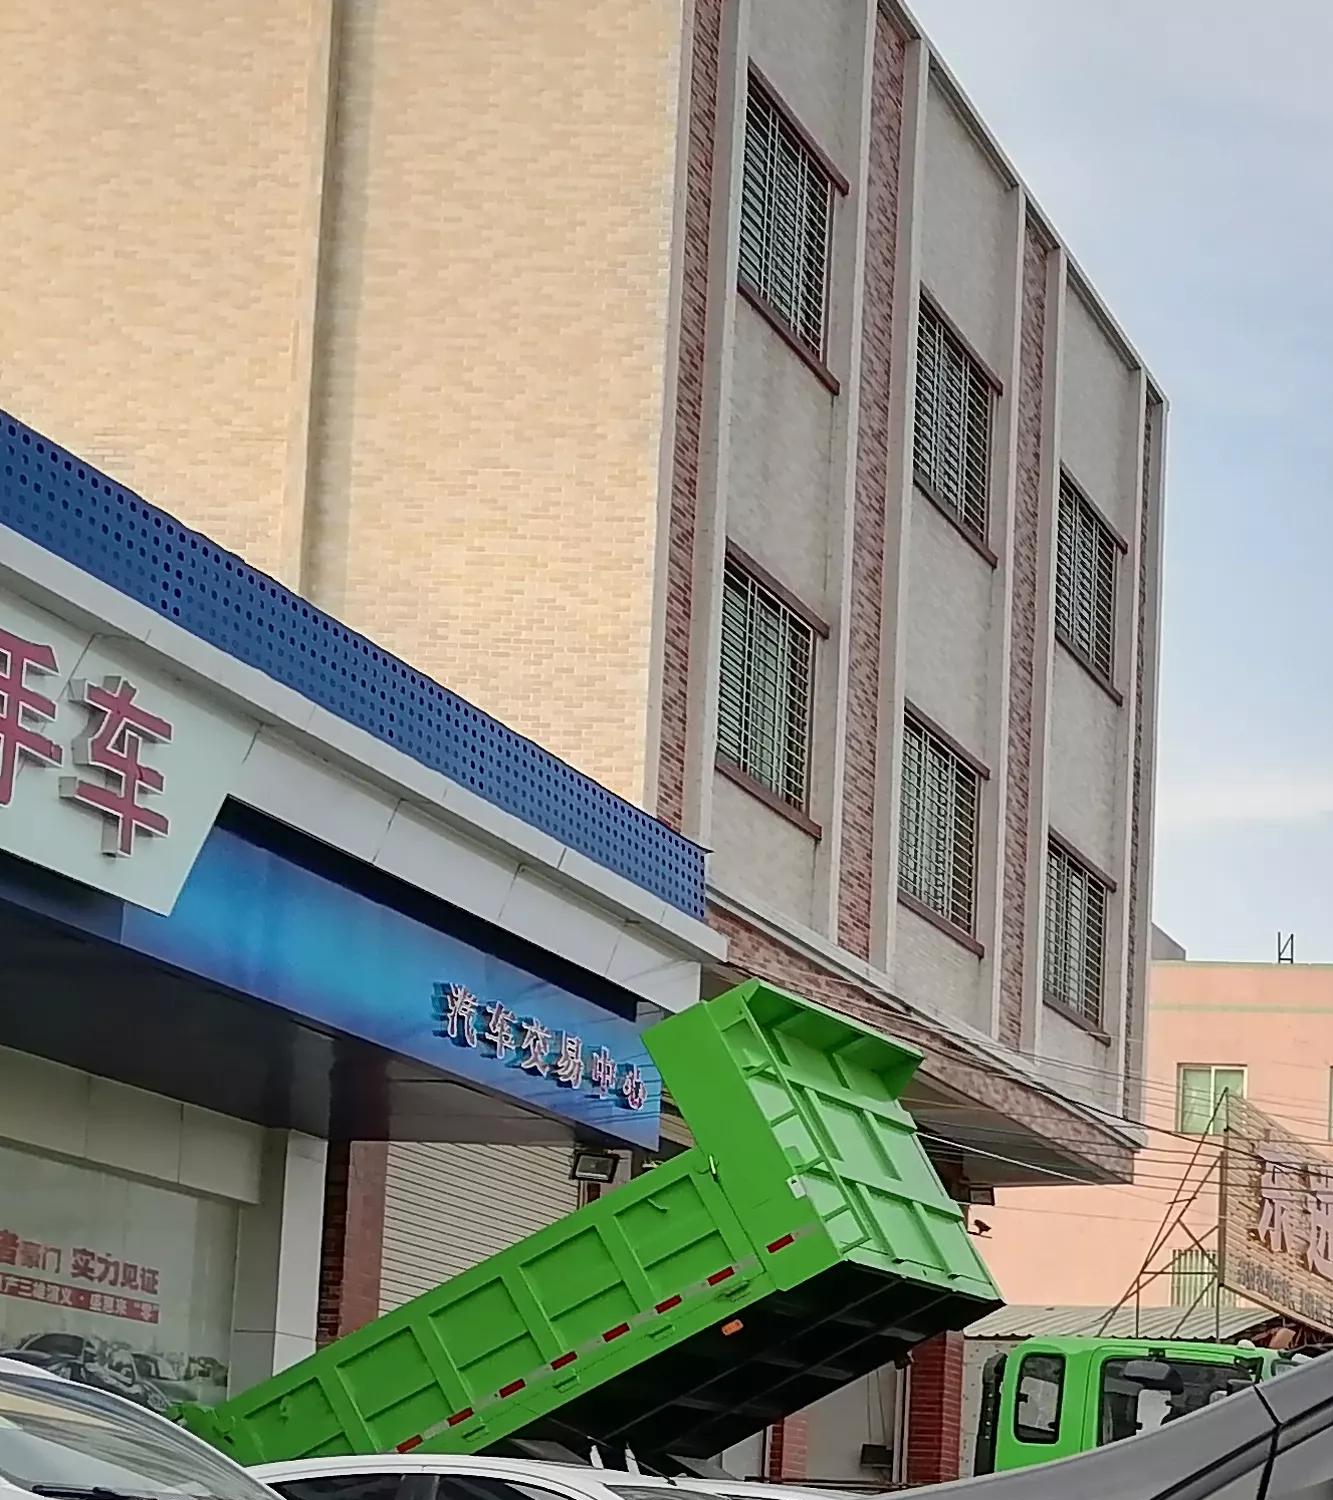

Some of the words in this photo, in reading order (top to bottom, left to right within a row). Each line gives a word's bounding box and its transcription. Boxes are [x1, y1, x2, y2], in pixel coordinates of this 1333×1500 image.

[447, 982, 648, 1110] 汽车交易中心
